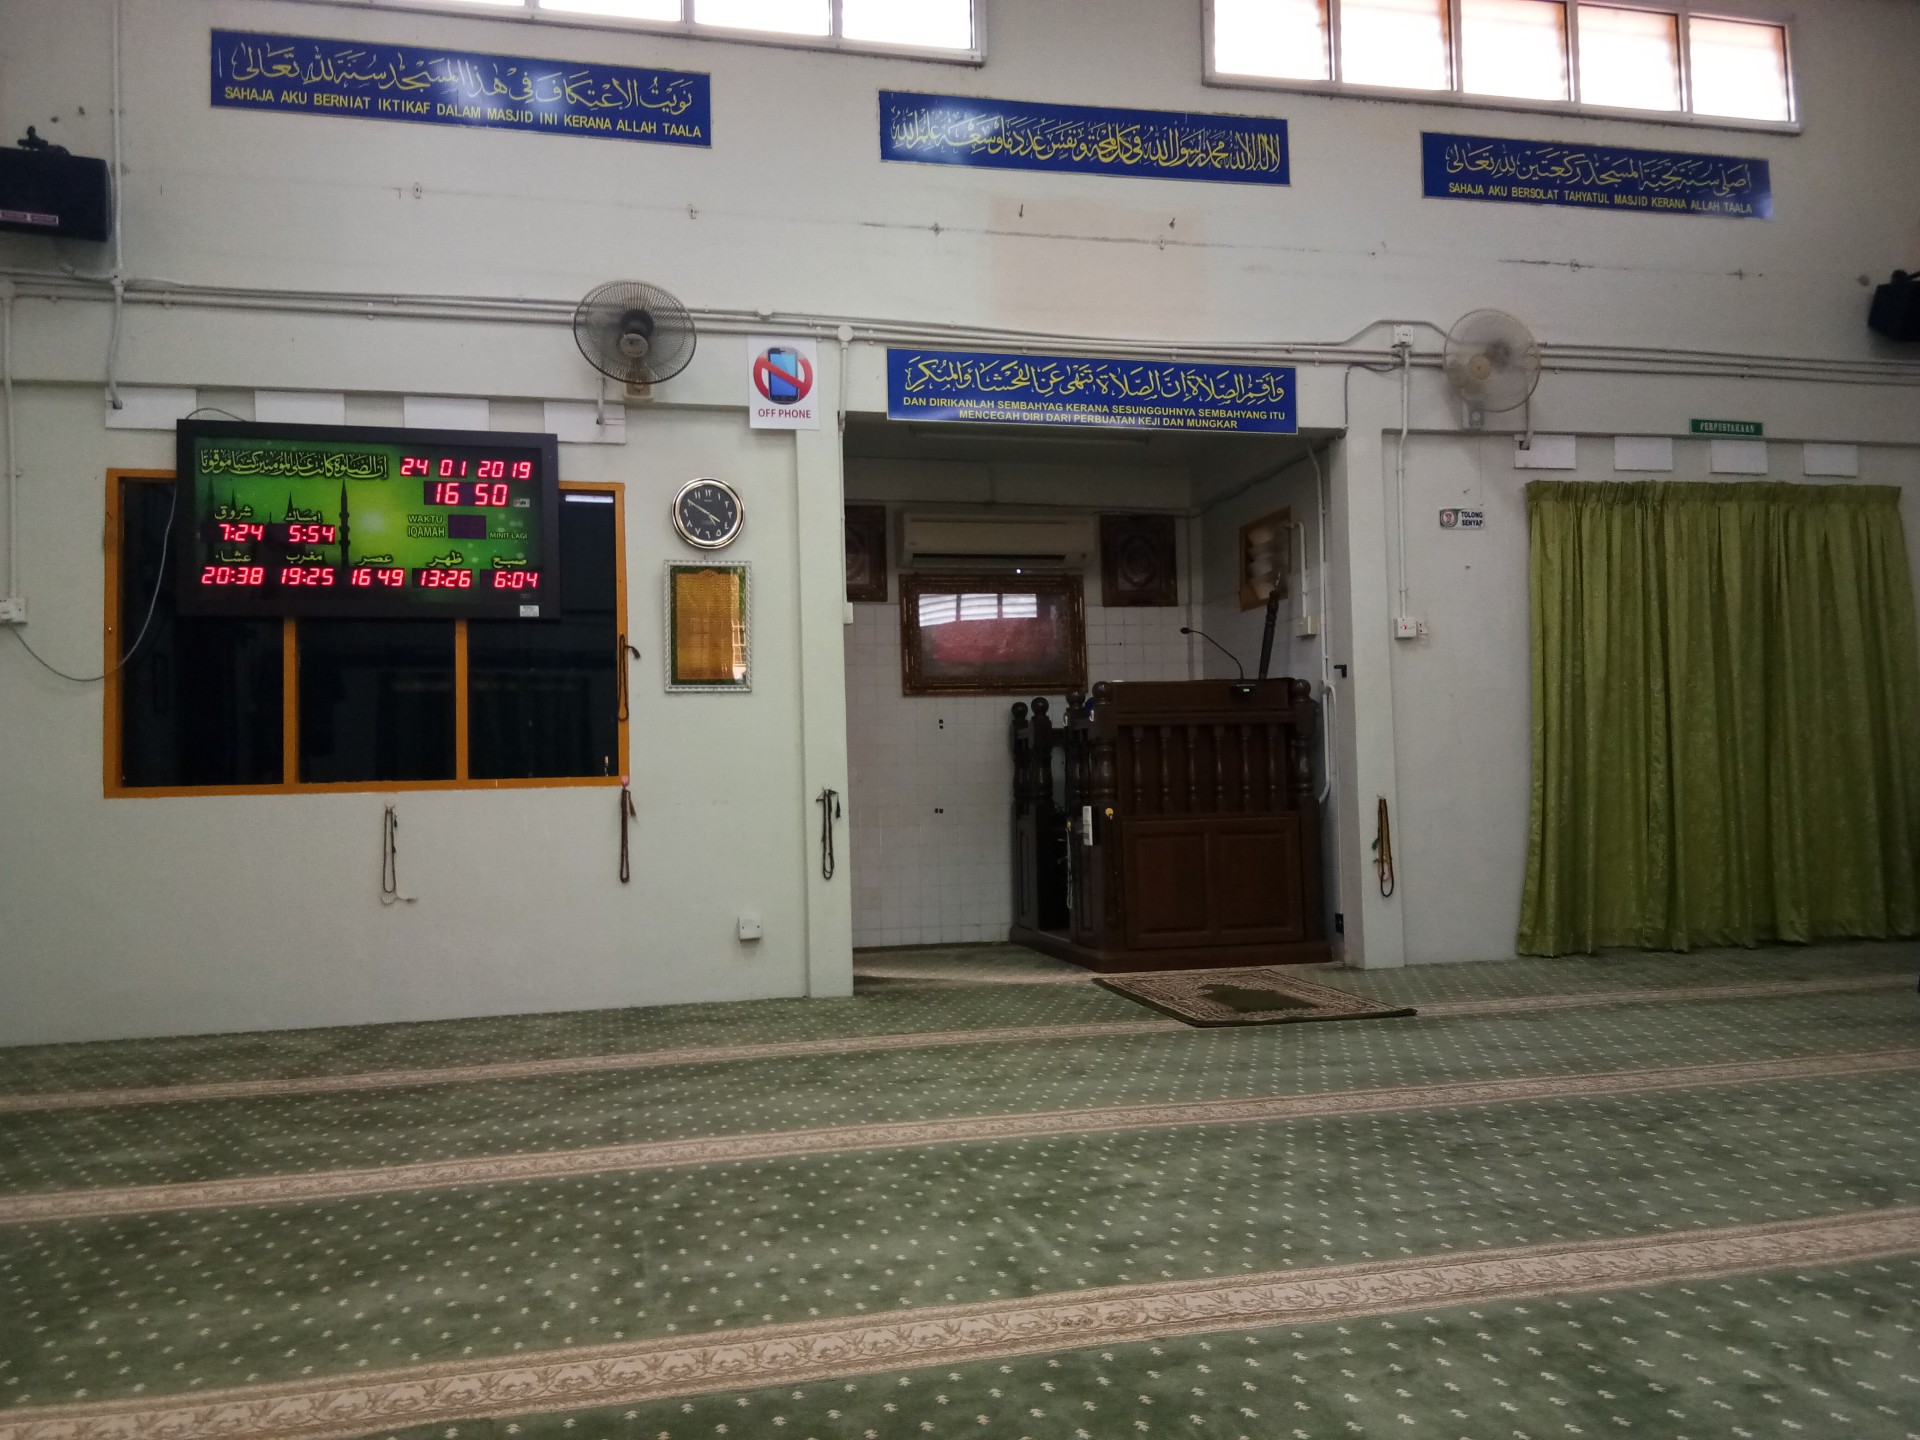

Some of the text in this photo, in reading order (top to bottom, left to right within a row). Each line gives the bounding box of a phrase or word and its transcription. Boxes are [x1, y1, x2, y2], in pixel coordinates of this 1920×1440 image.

[224, 86, 702, 138] SAHAJA AKU BERNIAT IKTIKAF DALAM MASJID INI KERANA ALLAH TAALA
[1448, 182, 1752, 213] SAHAJA AKU BERSOLAT TAHYATUL MASJID KERANA ALLAH TAALA
[758, 408, 811, 419] OFF PHONE
[903, 397, 1286, 420] DAN DIRIKANLAH SEMBAHYAG KERANA SESUNGGUHNYA SEMBAHYANG ITU
[959, 410, 1238, 429] MENCEGAH DIRI DARI PERBUATAN KEJI DAN MUNGKAR
[401, 458, 532, 479] 24 01 2019
[436, 483, 459, 504] 16
[475, 484, 508, 506] 50
[215, 505, 252, 520] شروق
[408, 515, 443, 523] WAKTU
[1461, 519, 1483, 527] SENYAP
[219, 523, 264, 541] 7:24
[289, 525, 335, 543] 5:54
[408, 526, 445, 538] IQAMAH
[286, 551, 323, 564] مغرب
[358, 553, 392, 565] عصر
[427, 551, 463, 567] ظهر
[492, 556, 527, 568] صبح
[201, 566, 264, 584] 20:38
[281, 567, 334, 585] 19:25
[420, 570, 471, 587] 13:26
[494, 571, 538, 588] 6:04
